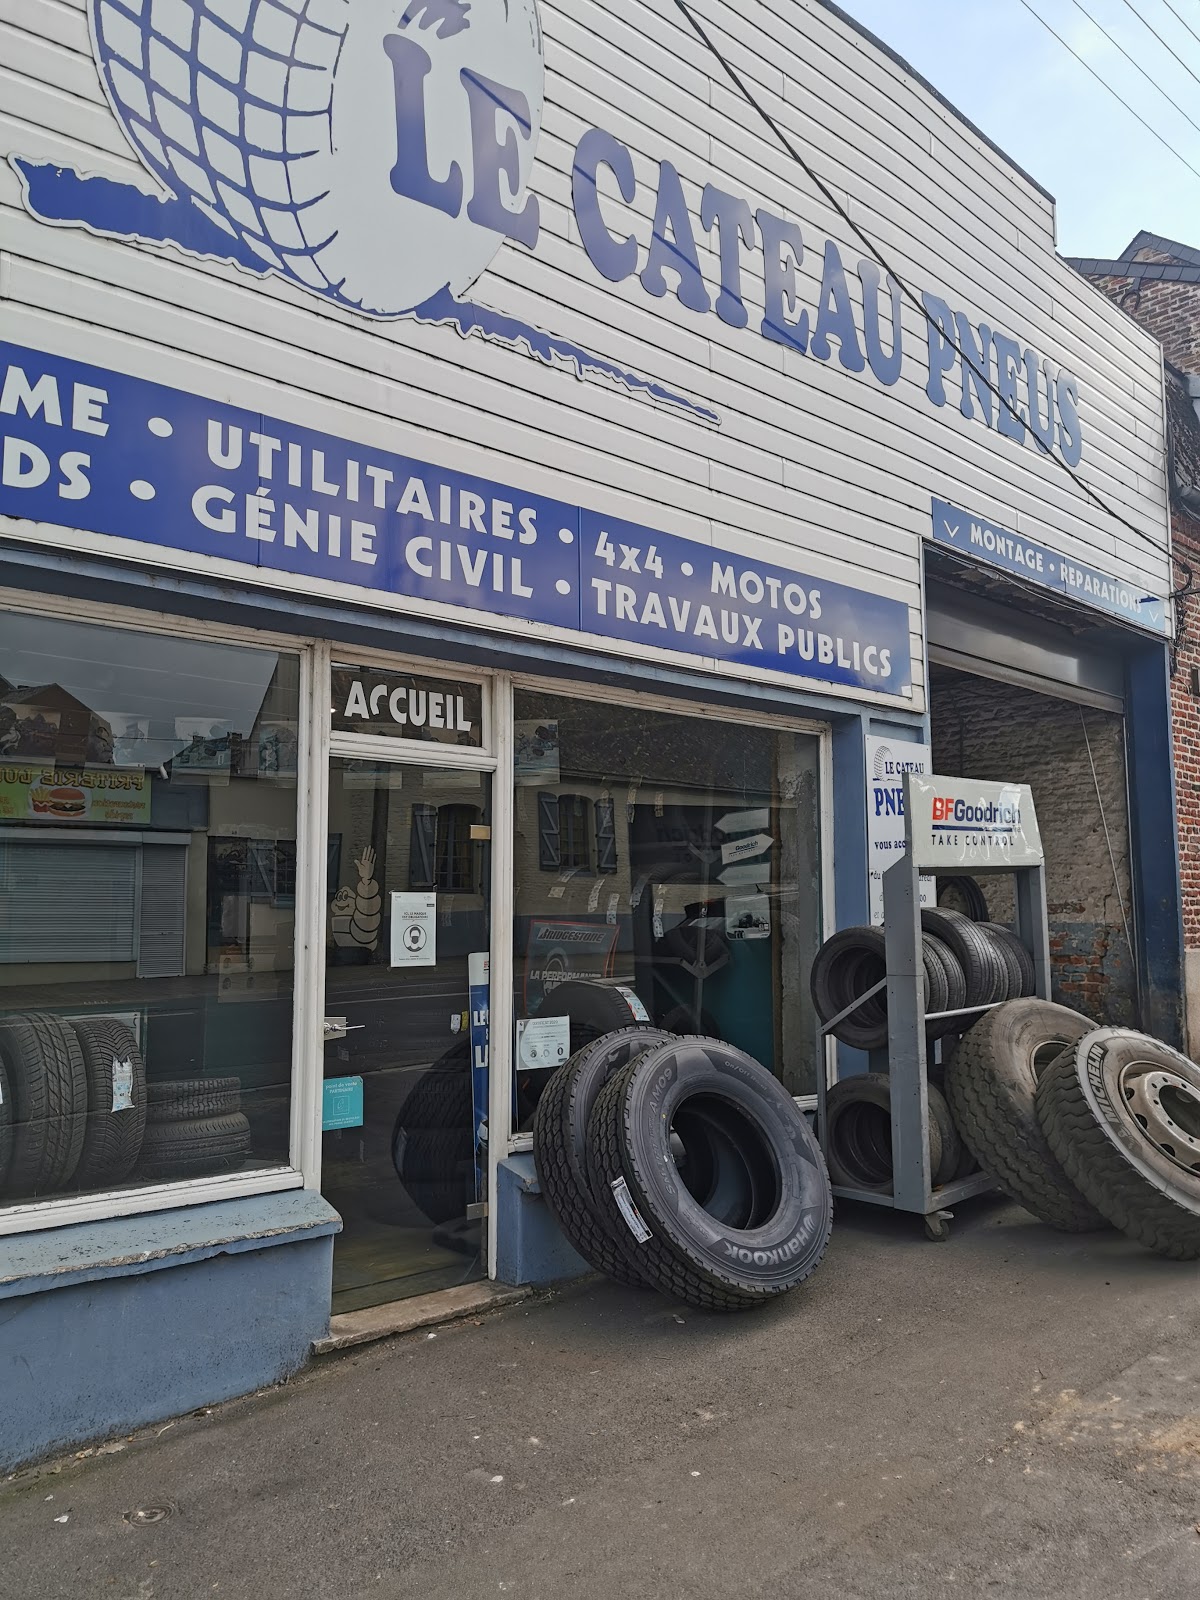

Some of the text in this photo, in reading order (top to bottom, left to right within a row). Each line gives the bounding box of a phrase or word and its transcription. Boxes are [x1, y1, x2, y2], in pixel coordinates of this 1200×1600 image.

[382, 33, 1082, 467] LE CATEAU PNEUS
[207, 418, 538, 545] UTILITAIRES
[594, 531, 664, 579] 4x4
[711, 561, 822, 619] MOTOS
[2, 435, 892, 677] DS GÉNIE CIVIL TRAVAUX PUBLICS
[970, 522, 1142, 614] MONTAGE REPARATIONS
[343, 680, 472, 732] ACCUEIL
[884, 761, 924, 775] LE CATEAU
[873, 788, 904, 817] PNE
[931, 797, 1021, 824] BFGoodrich
[874, 840, 893, 850] vous
[931, 834, 1014, 846] TAKE CONTROL
[1087, 1042, 1120, 1124] MICHELIN
